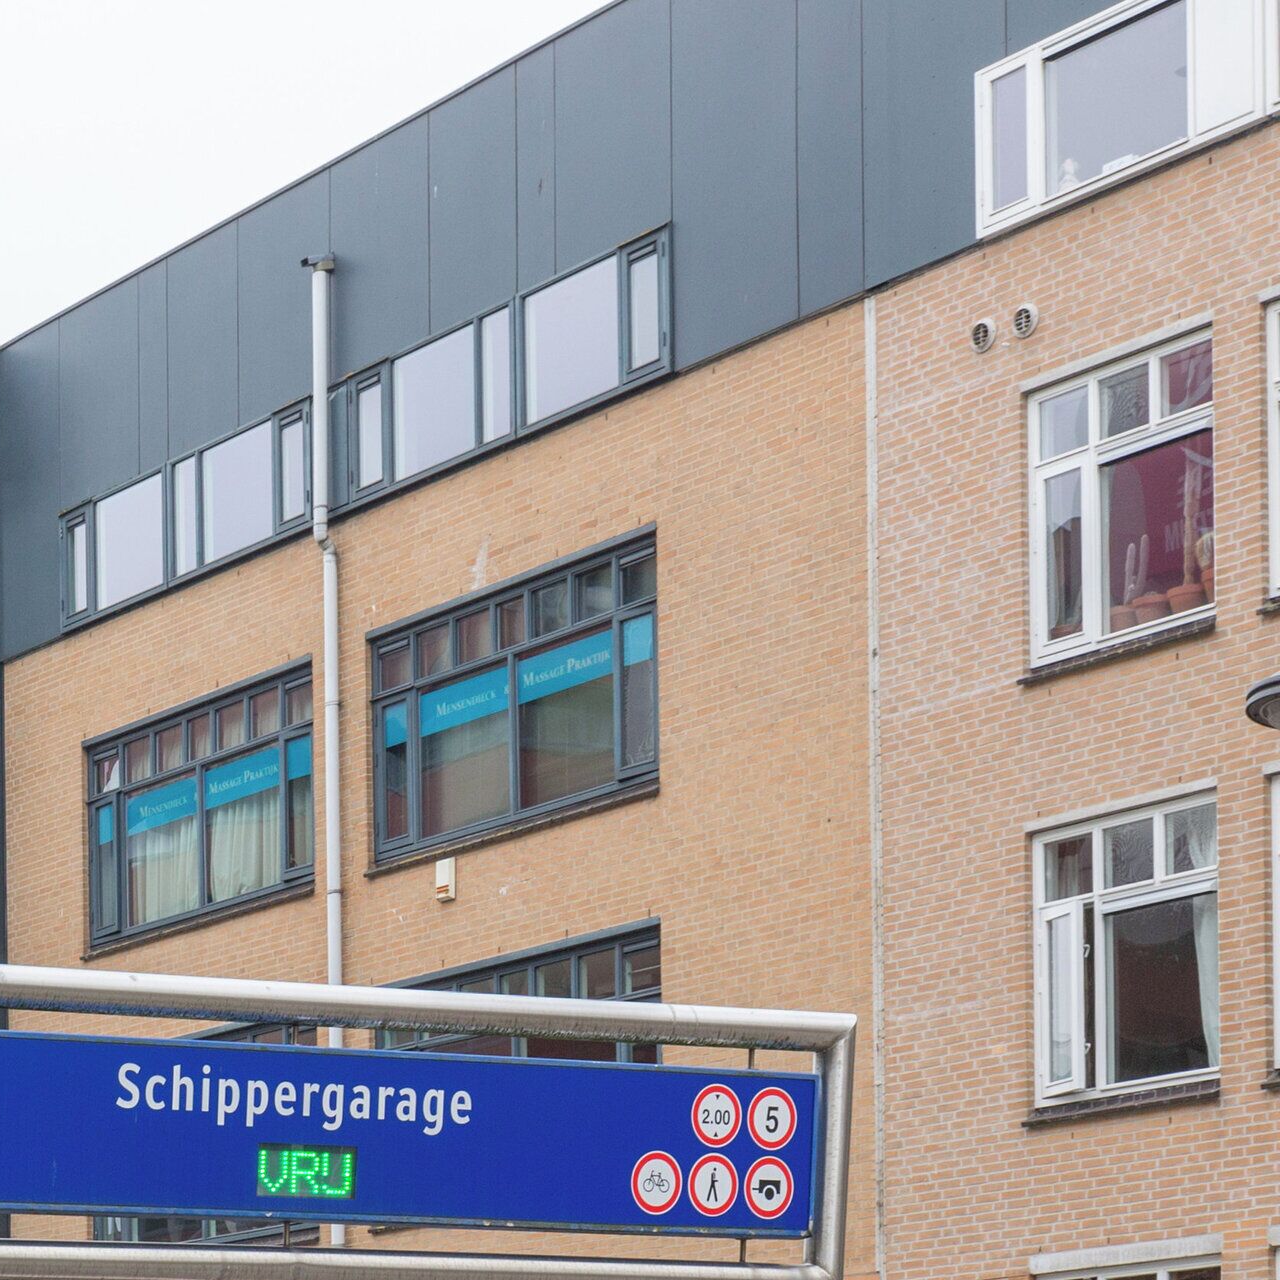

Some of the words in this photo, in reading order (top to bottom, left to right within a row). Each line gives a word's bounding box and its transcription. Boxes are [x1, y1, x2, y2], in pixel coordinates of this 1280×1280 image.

[115, 1062, 473, 1136] Schippergarage
[702, 1108, 731, 1126] 2.00
[765, 1106, 779, 1134] 5
